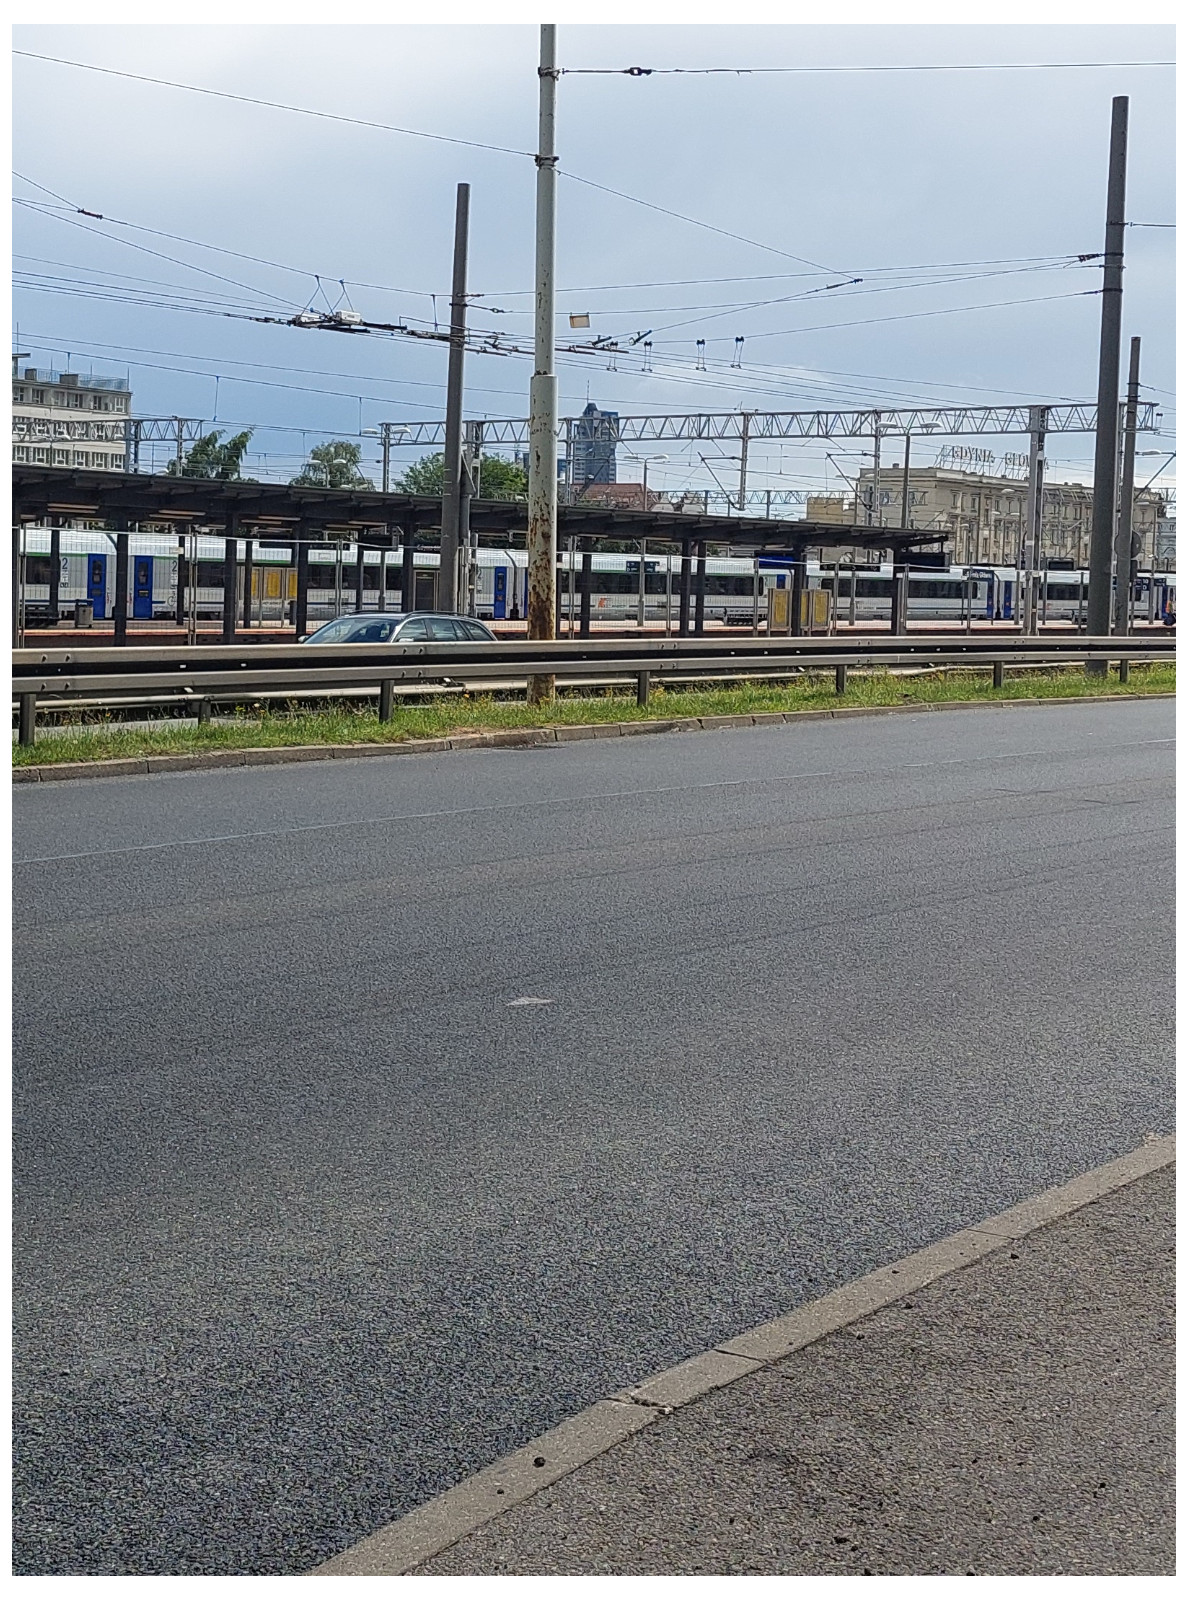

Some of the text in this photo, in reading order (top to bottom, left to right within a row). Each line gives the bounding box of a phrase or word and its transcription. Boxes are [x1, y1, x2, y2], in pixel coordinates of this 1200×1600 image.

[952, 446, 994, 463] GDYNIA
[62, 557, 68, 570] 2
[171, 560, 178, 572] 2
